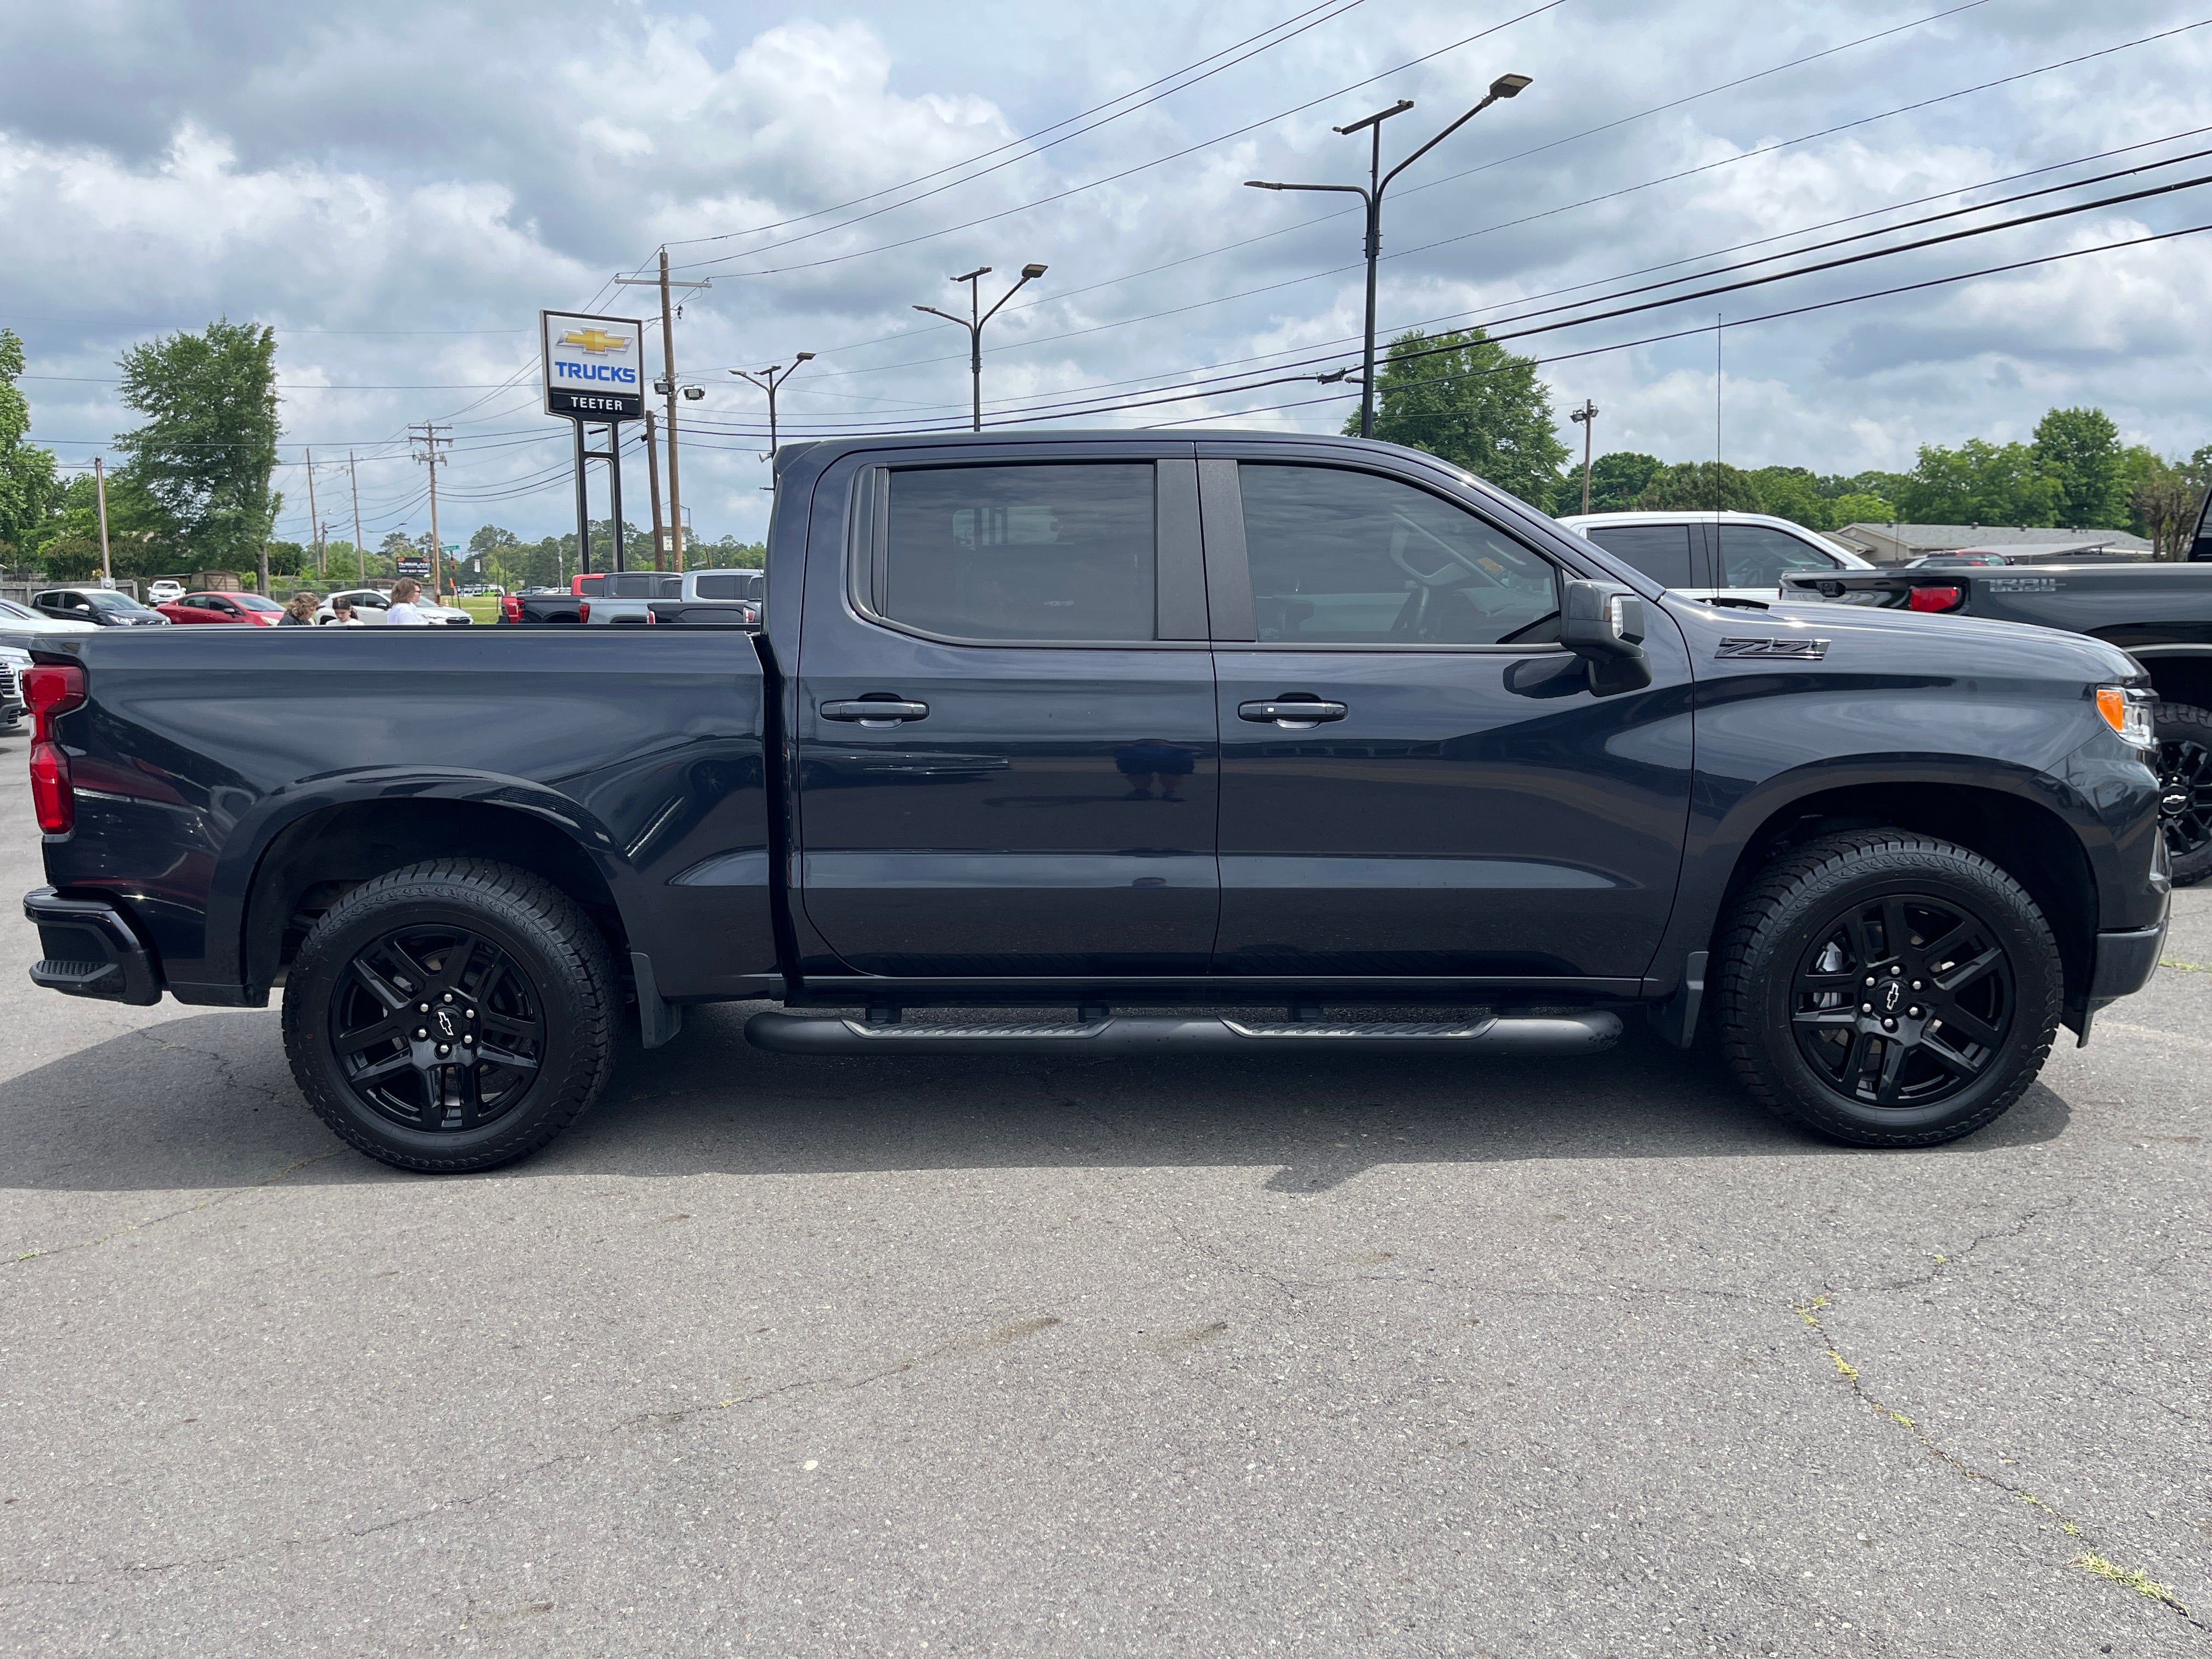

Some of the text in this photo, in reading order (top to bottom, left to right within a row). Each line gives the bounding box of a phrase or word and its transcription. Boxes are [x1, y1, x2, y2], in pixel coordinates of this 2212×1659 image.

[555, 362, 636, 383] TRUCKS
[571, 396, 623, 411] TEETER
[1714, 637, 1832, 661] Z71
